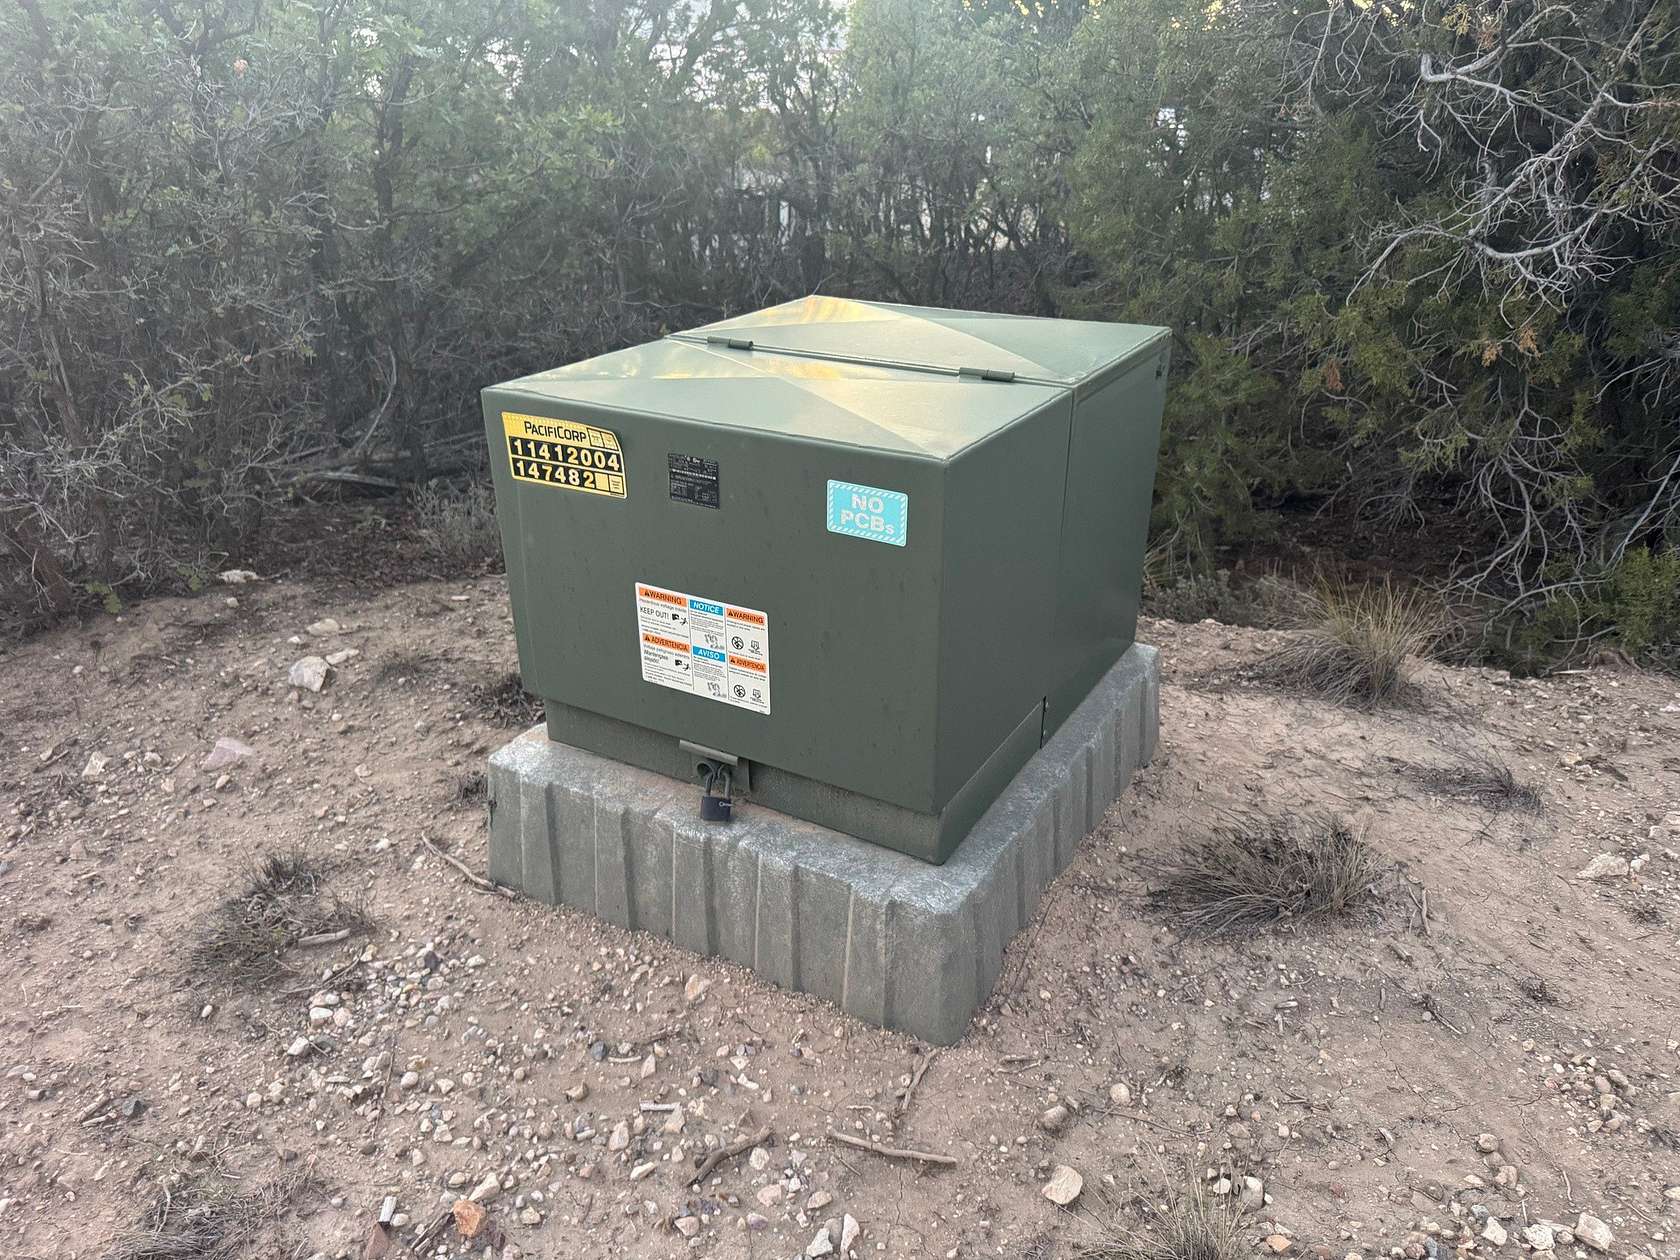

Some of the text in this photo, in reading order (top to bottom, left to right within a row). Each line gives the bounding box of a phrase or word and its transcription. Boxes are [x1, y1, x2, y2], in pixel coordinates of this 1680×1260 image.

[514, 439, 620, 471] 11412004
[517, 460, 595, 489] 147482
[851, 493, 884, 513] NO
[840, 509, 895, 535] PCBs
[649, 591, 682, 605] WARNING
[640, 606, 670, 619] KEEP OUT!
[693, 601, 720, 613] NOTICE
[733, 611, 764, 623] WARNING
[651, 636, 688, 651] ADVERTENCIA
[698, 649, 720, 660] AVISO
[737, 659, 765, 671] ADVERTENCIA
